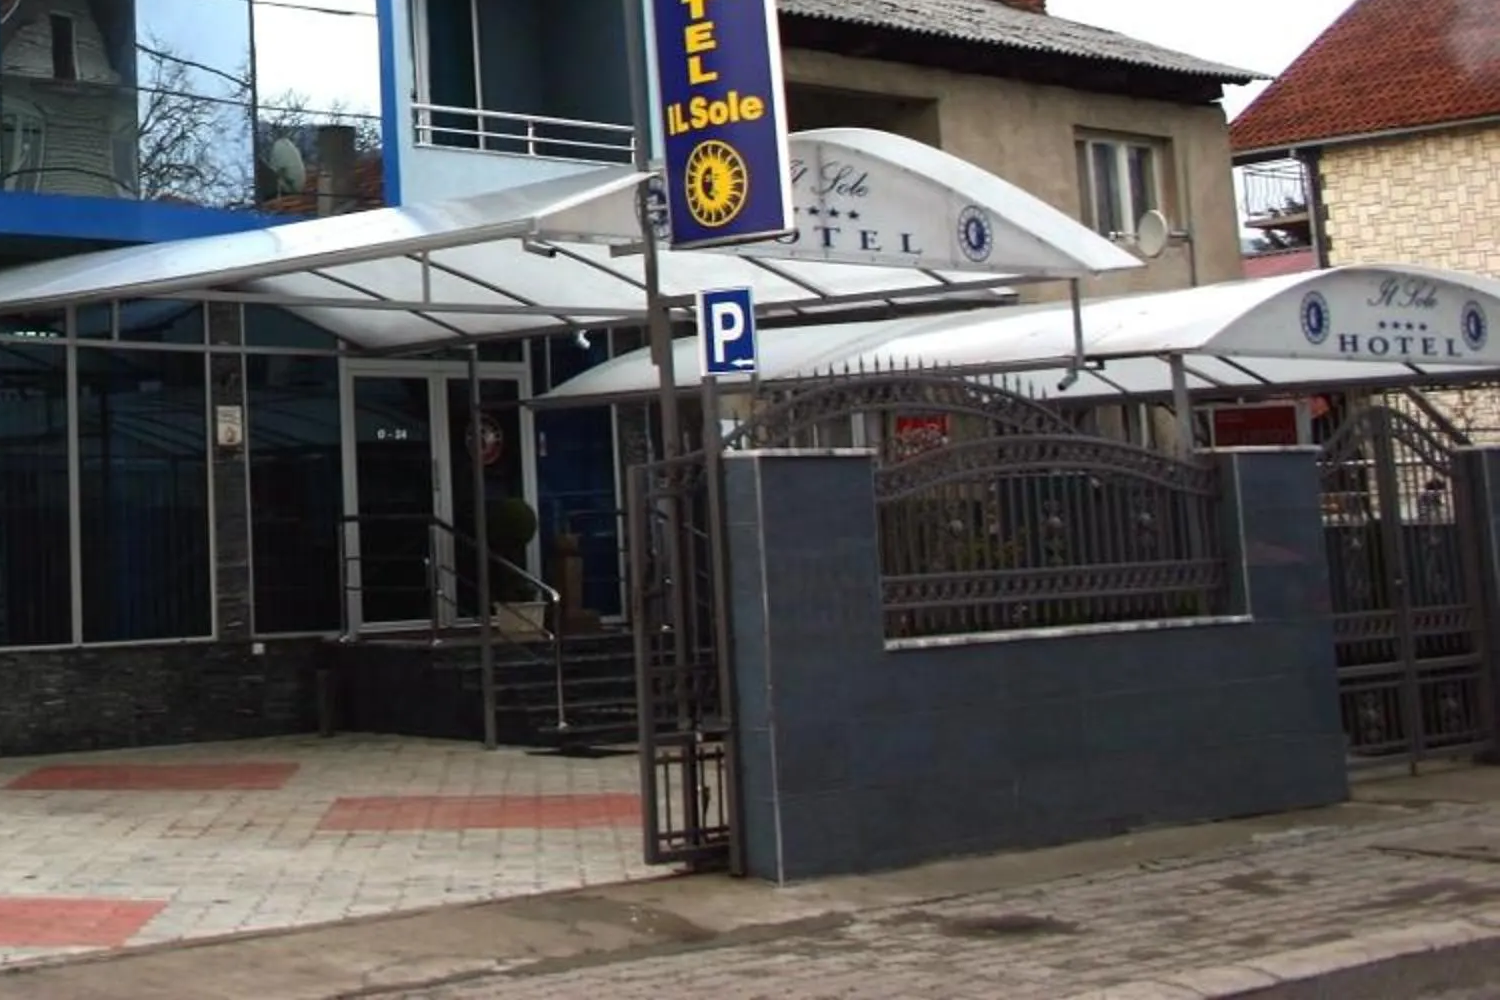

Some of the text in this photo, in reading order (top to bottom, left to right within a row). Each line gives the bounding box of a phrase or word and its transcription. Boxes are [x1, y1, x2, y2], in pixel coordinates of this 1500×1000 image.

[777, 226, 923, 254] TEL
[711, 301, 745, 364] P
[1338, 333, 1462, 358] HOTEL
